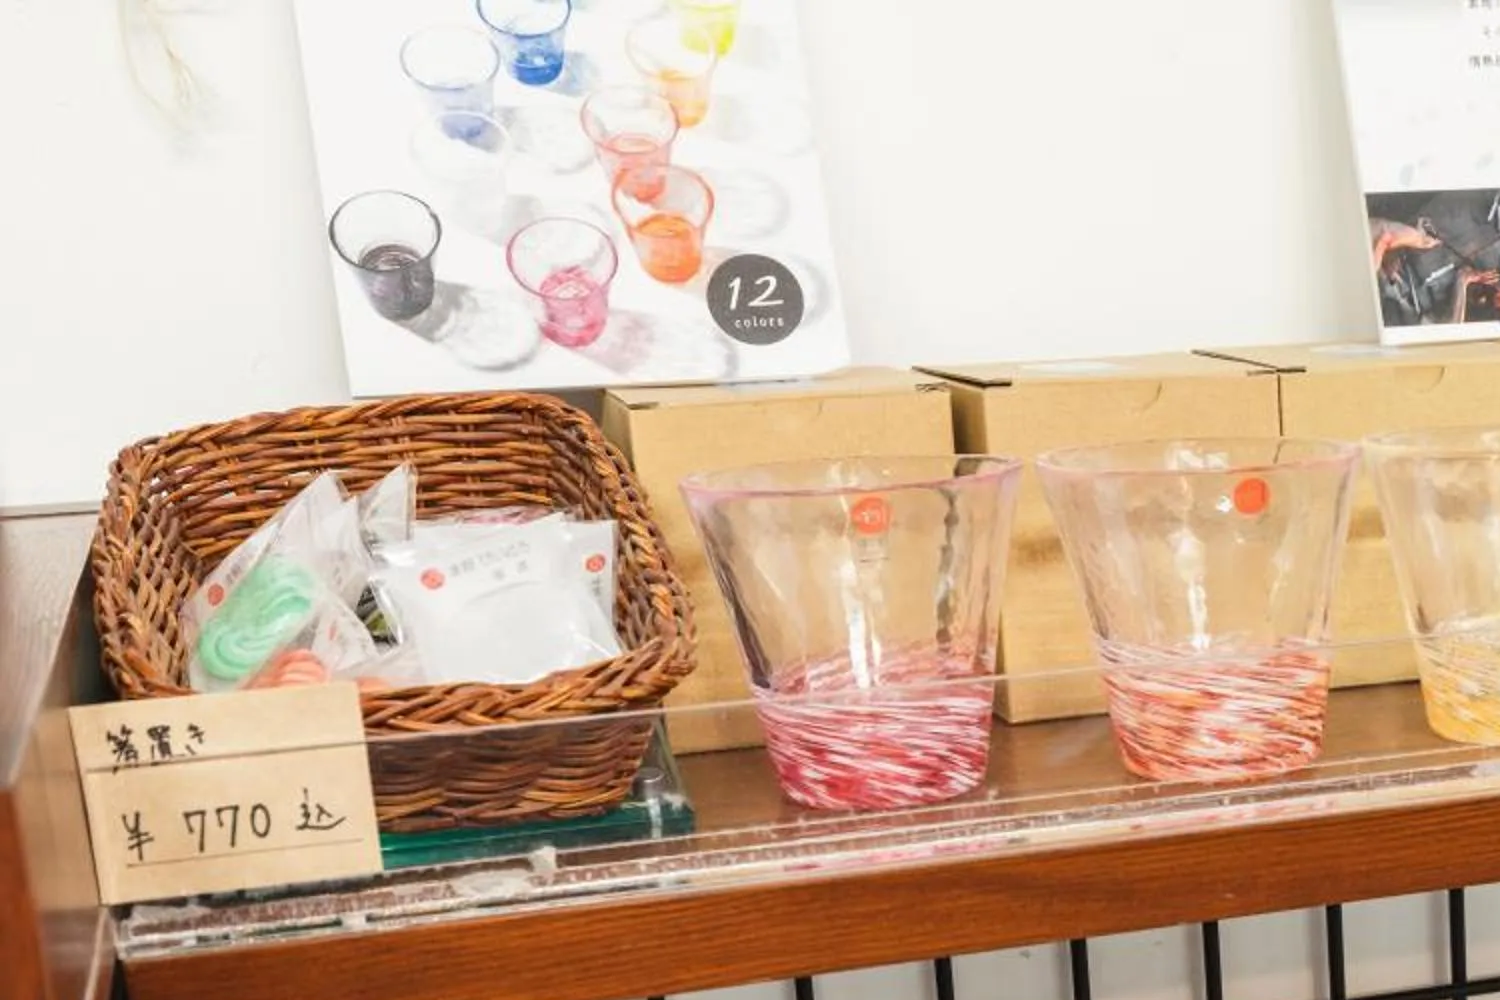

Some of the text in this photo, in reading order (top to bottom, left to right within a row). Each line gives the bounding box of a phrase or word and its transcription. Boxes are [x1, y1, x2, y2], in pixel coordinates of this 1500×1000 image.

[728, 275, 784, 310] 12
[734, 315, 784, 328] colors
[183, 803, 272, 853] 770
